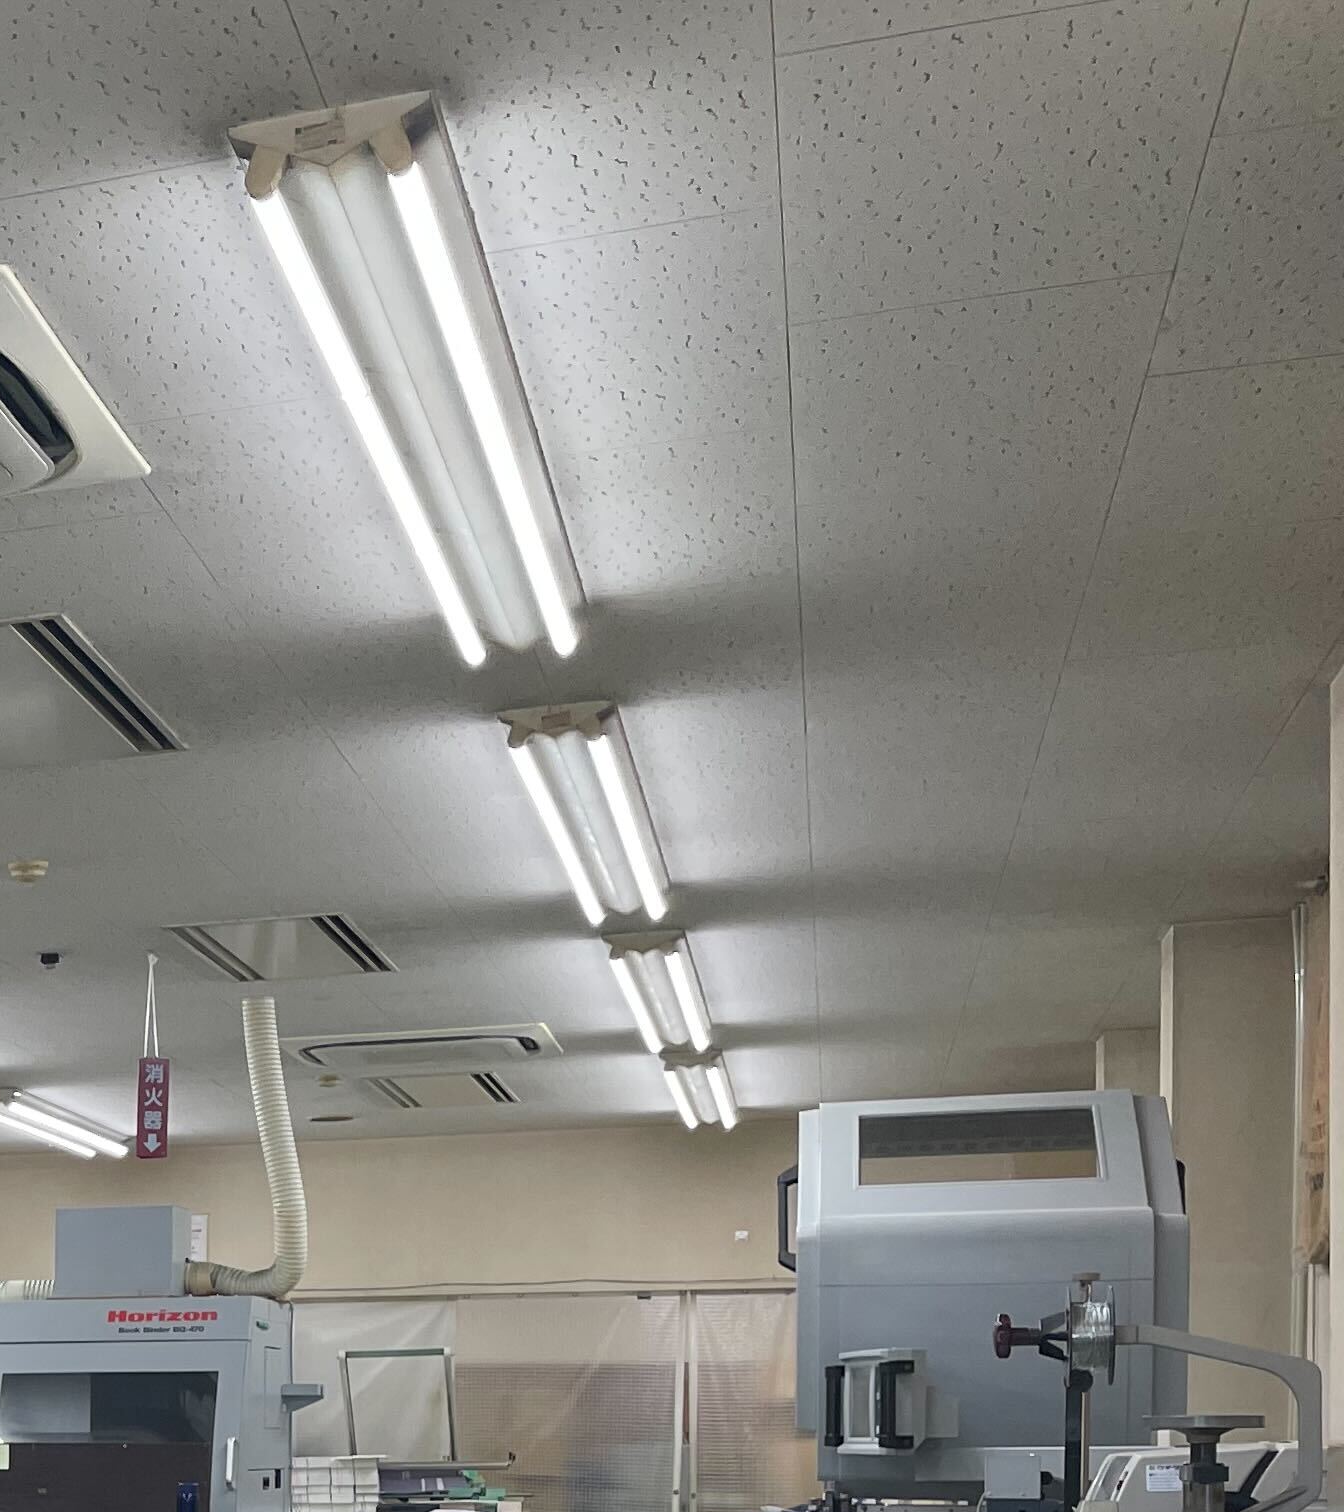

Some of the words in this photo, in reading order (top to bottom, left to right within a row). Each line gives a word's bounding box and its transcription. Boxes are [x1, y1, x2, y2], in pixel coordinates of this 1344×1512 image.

[144, 1064, 164, 1130] 消火器
[108, 1310, 218, 1323] Horizon
